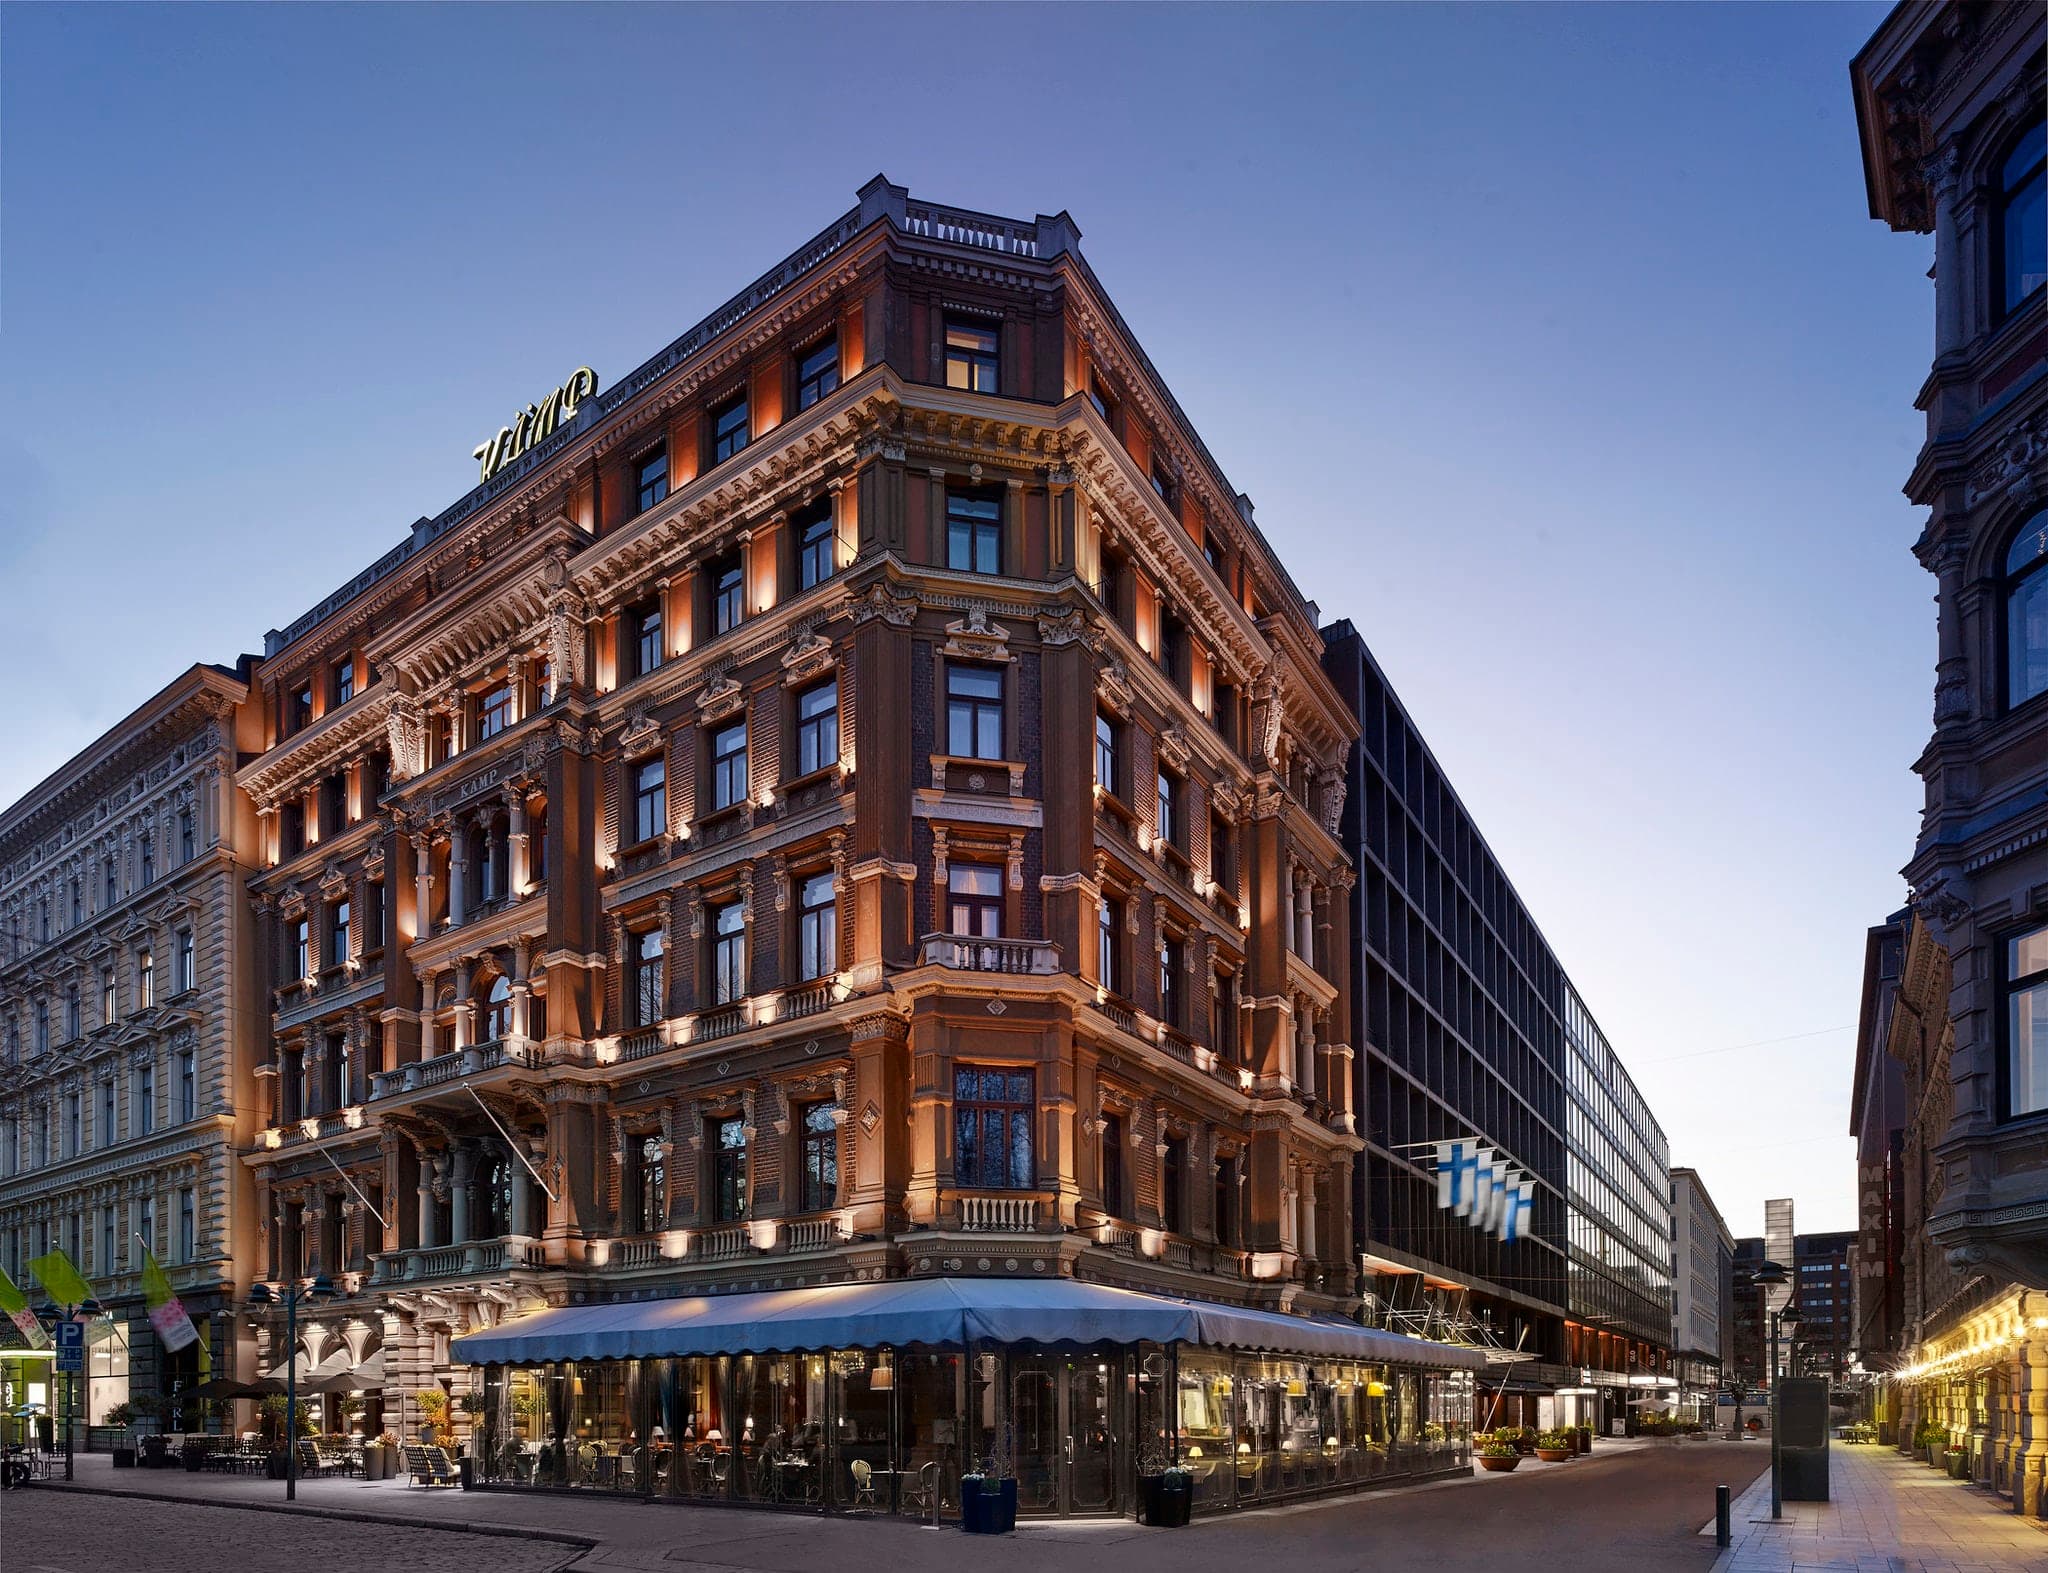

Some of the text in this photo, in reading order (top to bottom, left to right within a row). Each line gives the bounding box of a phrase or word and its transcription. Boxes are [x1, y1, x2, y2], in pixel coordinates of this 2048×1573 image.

[1859, 1166, 1885, 1279] MAXIM
[61, 1323, 80, 1345] P
[171, 1379, 184, 1432] FRL
